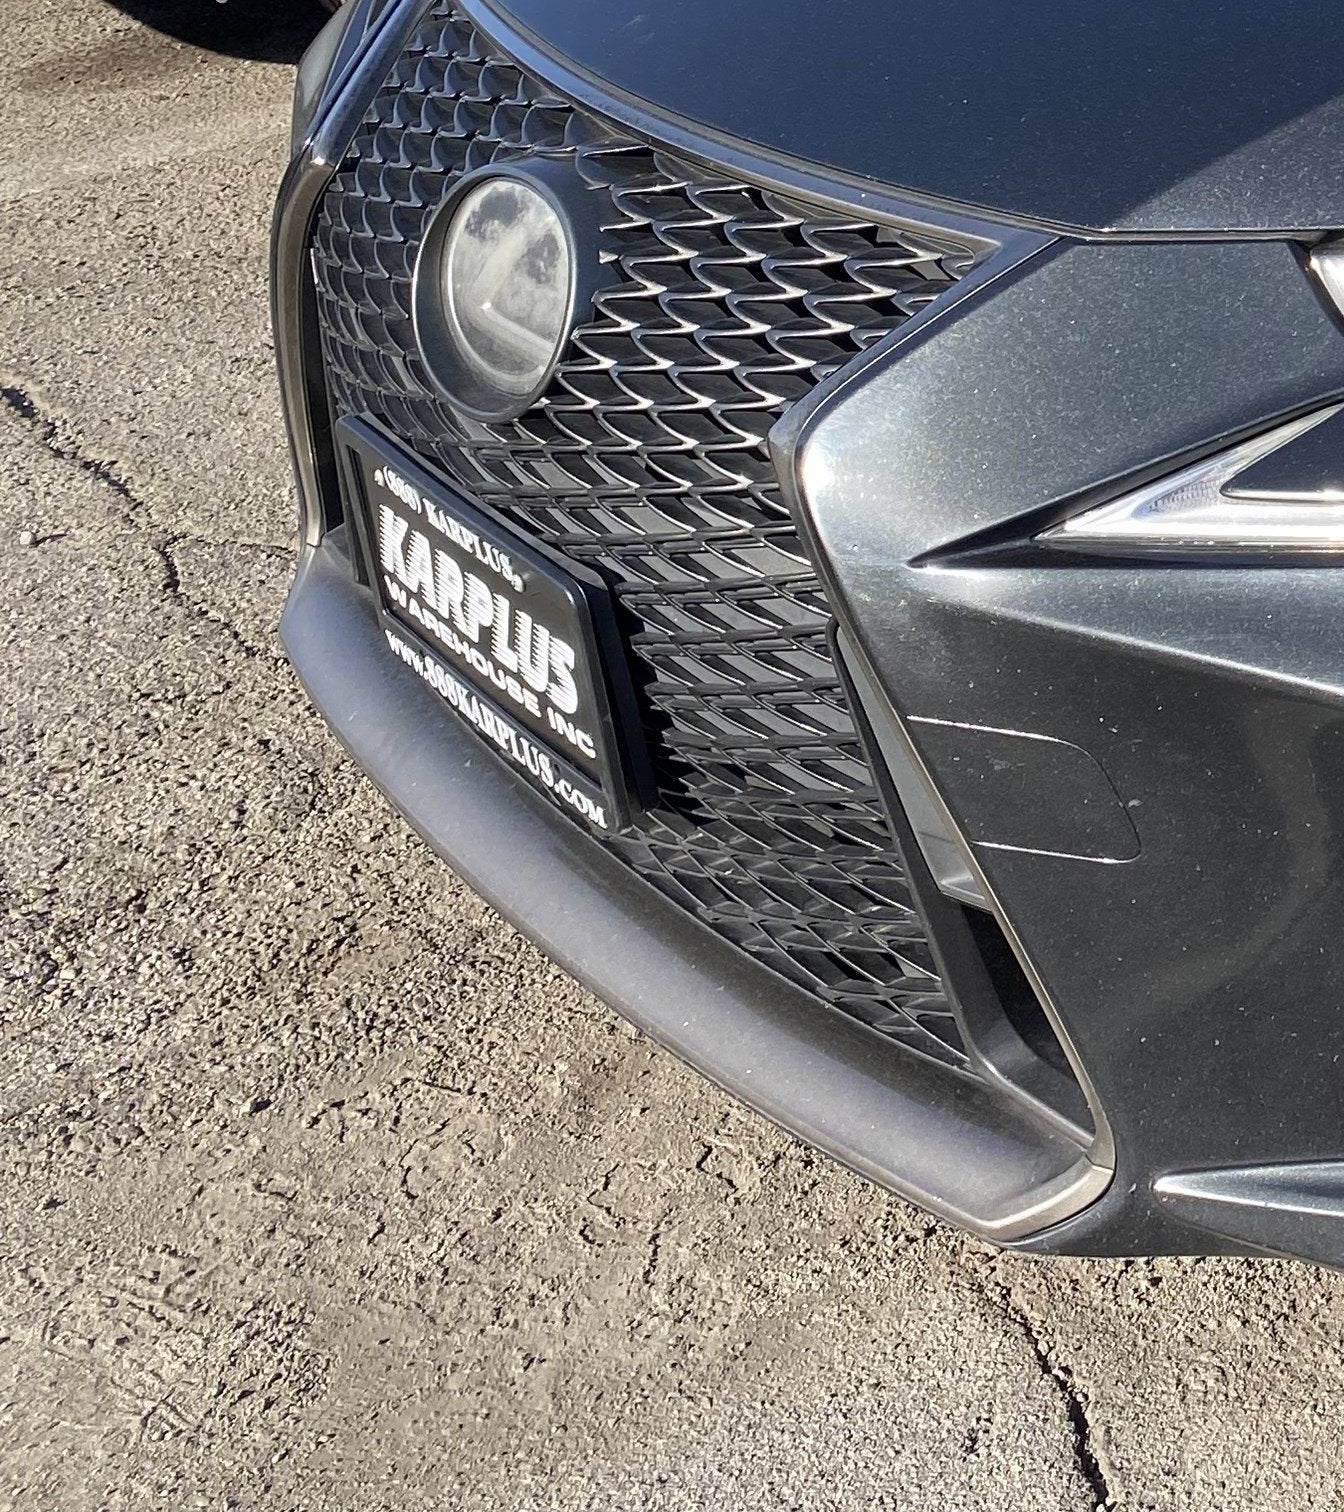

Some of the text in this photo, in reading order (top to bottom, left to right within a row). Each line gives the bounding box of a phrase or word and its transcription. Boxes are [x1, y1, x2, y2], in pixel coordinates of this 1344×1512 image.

[378, 503, 579, 714] KARPLUS
[422, 498, 515, 581] KARPLUS
[383, 574, 597, 759] WAREHOUSE INC
